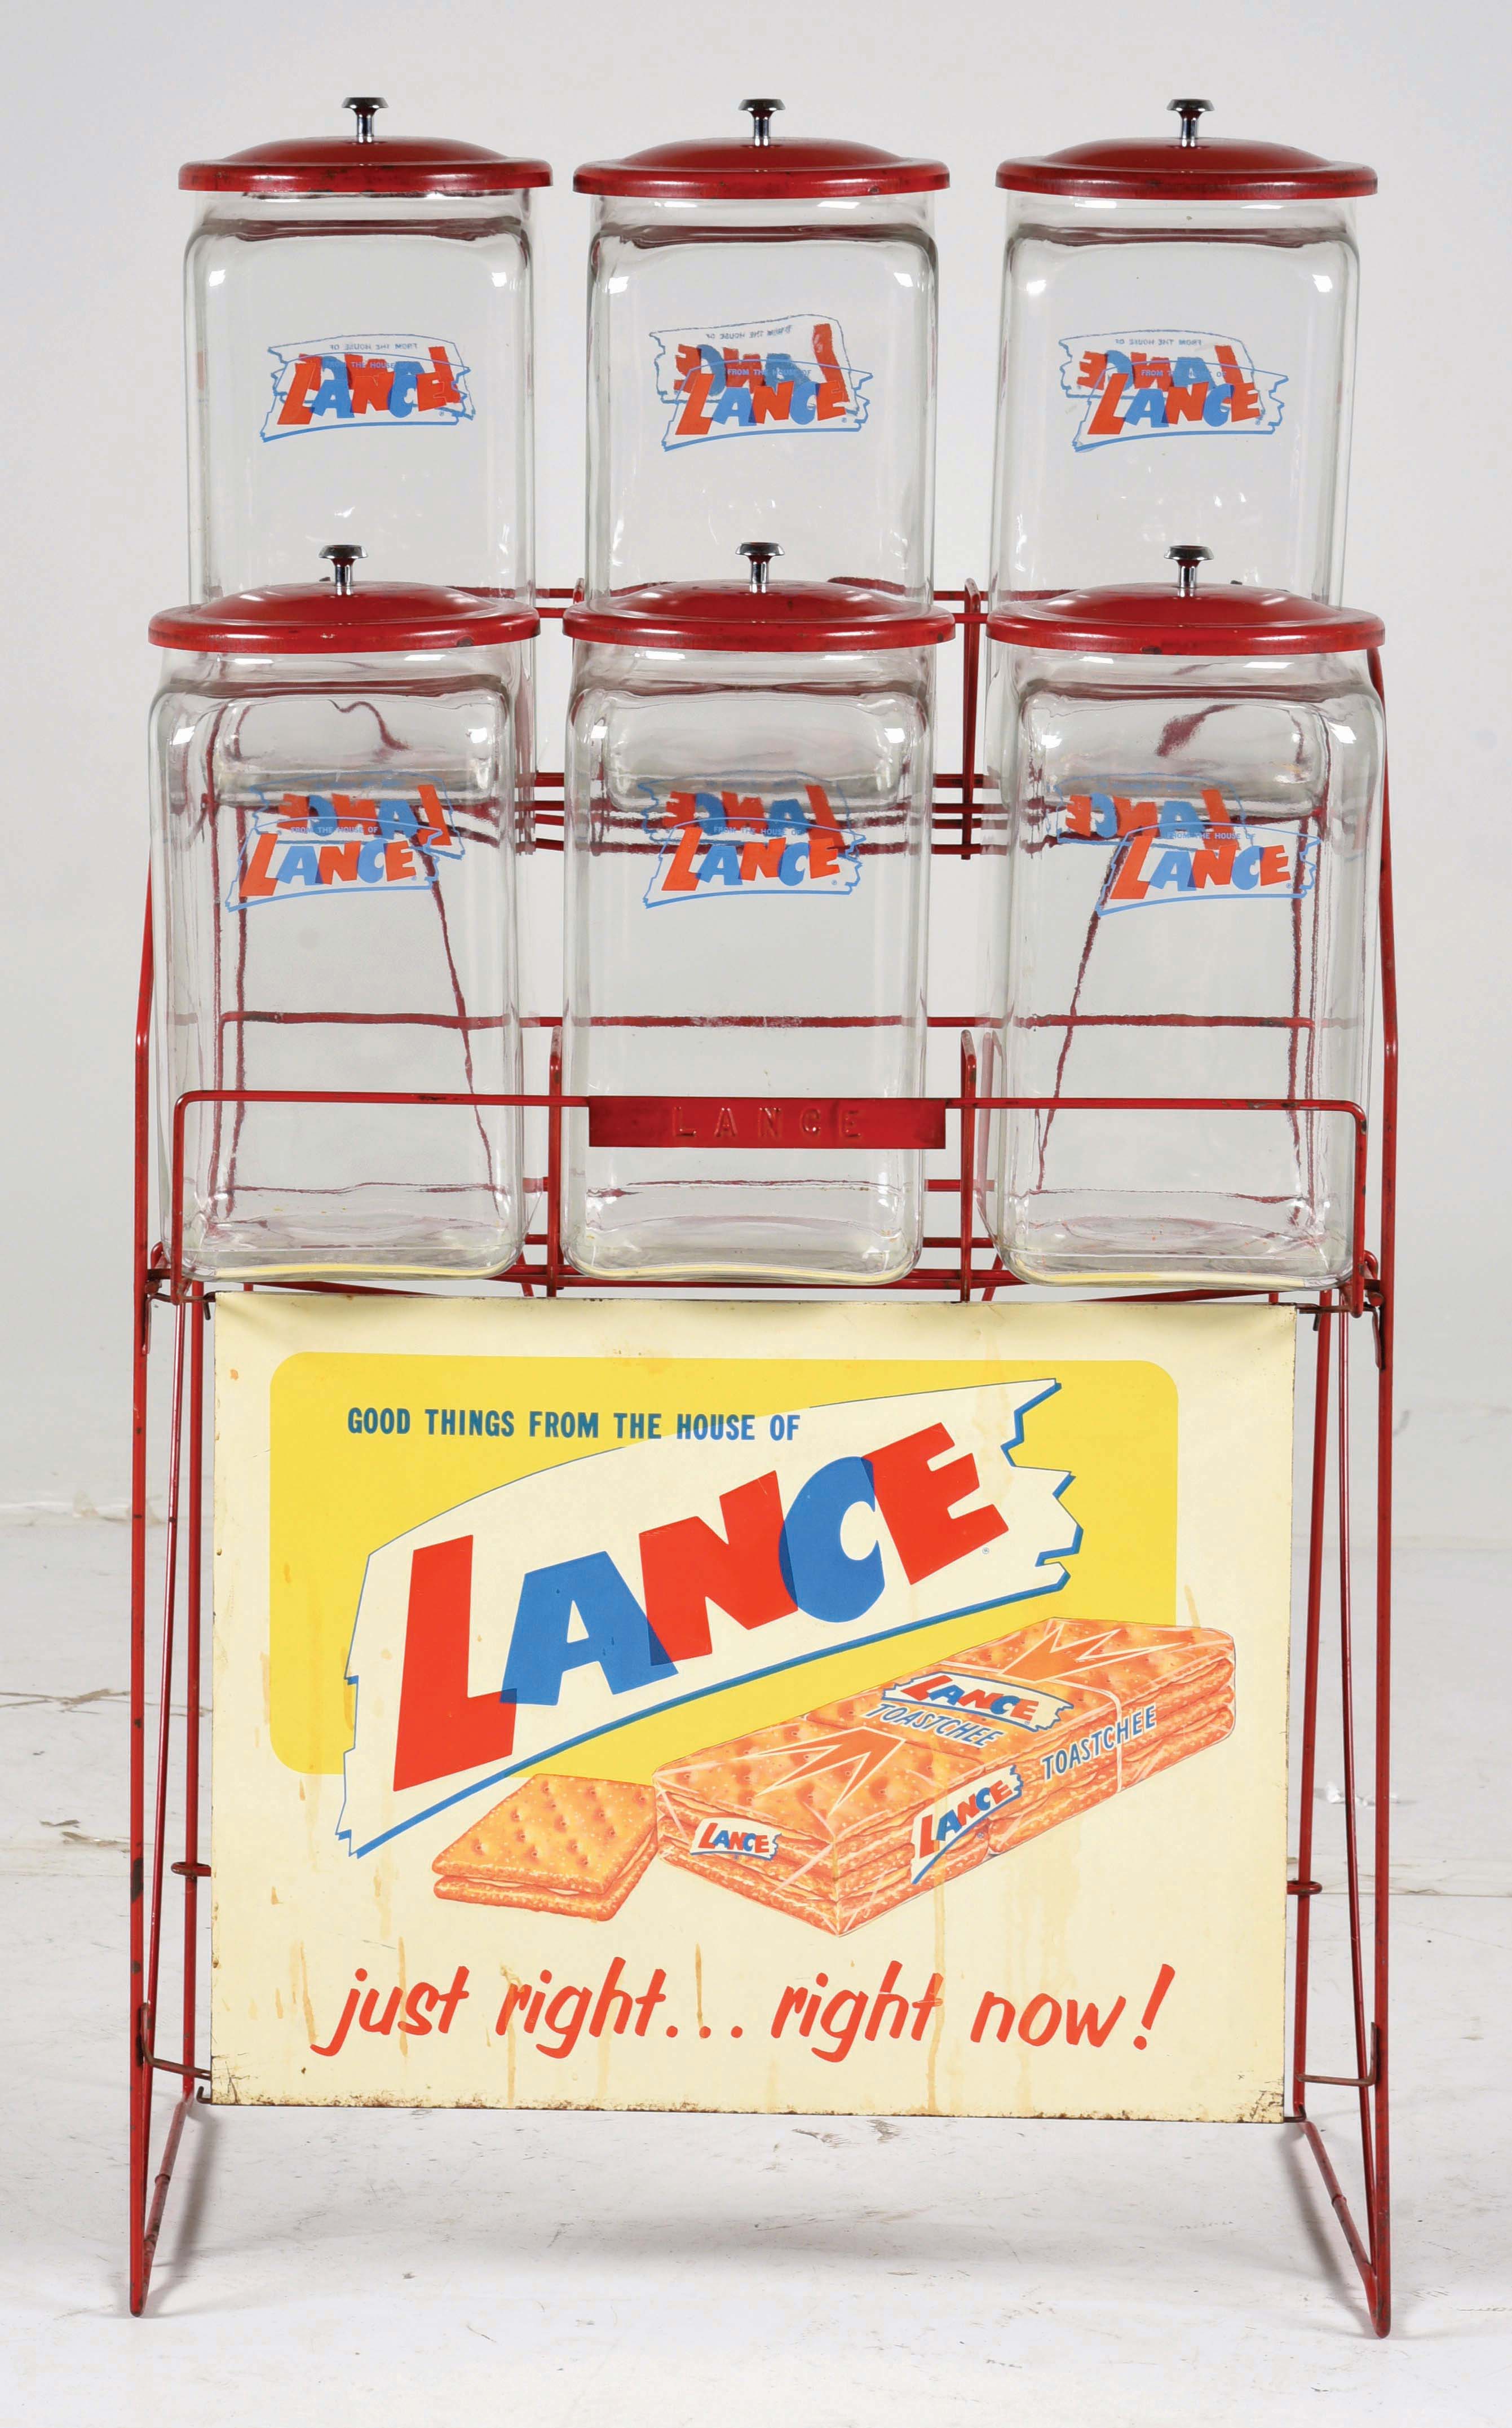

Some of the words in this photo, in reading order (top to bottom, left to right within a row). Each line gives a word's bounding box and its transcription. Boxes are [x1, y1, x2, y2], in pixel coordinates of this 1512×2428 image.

[277, 362, 446, 425] LANCE
[675, 373, 847, 435] LANCE
[1087, 373, 1261, 435] LANCE
[239, 833, 417, 896] LANCE
[661, 827, 841, 891] LANCE
[1109, 836, 1292, 900] LANCE
[673, 1106, 861, 1138] LANCE
[347, 1407, 411, 1435] GOOD
[424, 1409, 515, 1437] THINGS
[529, 1410, 599, 1438] FROM
[613, 1412, 662, 1440] THE
[676, 1413, 756, 1441] HOUSE
[769, 1414, 801, 1441] OF
[392, 1422, 1009, 1793] LANCE
[866, 1703, 1005, 1747] TOASTCHEE
[900, 1674, 1040, 1722] LANCE
[1042, 1705, 1157, 1780] TOASTCHEE
[698, 1822, 770, 1853] LANCE
[919, 1780, 1013, 1858] LANCE
[310, 1965, 470, 2057] just
[770, 1960, 944, 2063] right
